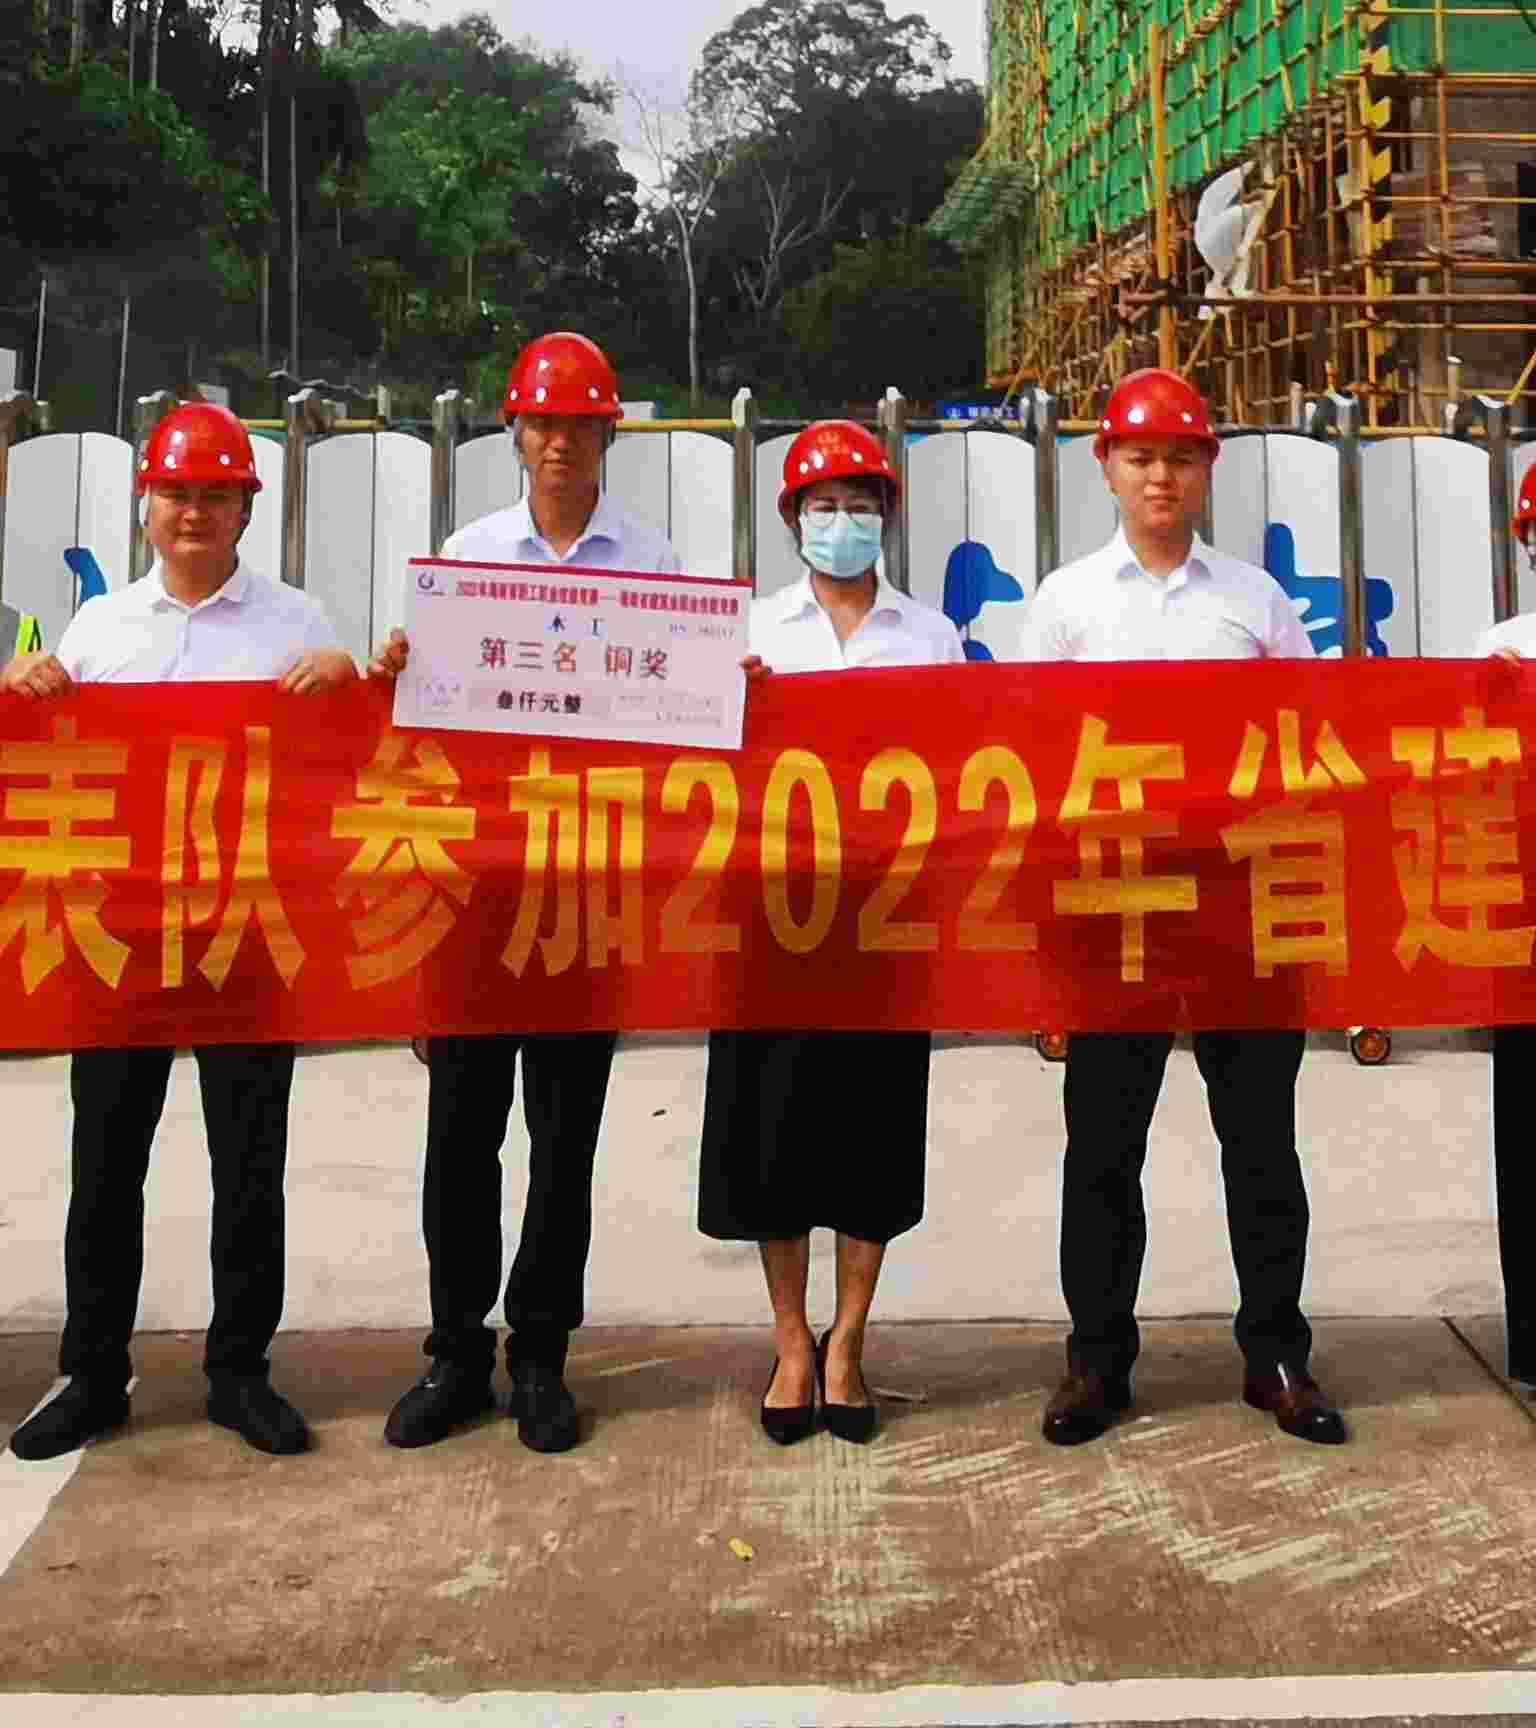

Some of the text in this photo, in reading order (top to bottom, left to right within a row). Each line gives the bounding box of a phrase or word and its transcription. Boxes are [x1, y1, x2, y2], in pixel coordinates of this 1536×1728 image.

[478, 634, 669, 681] 第三名 铜奖
